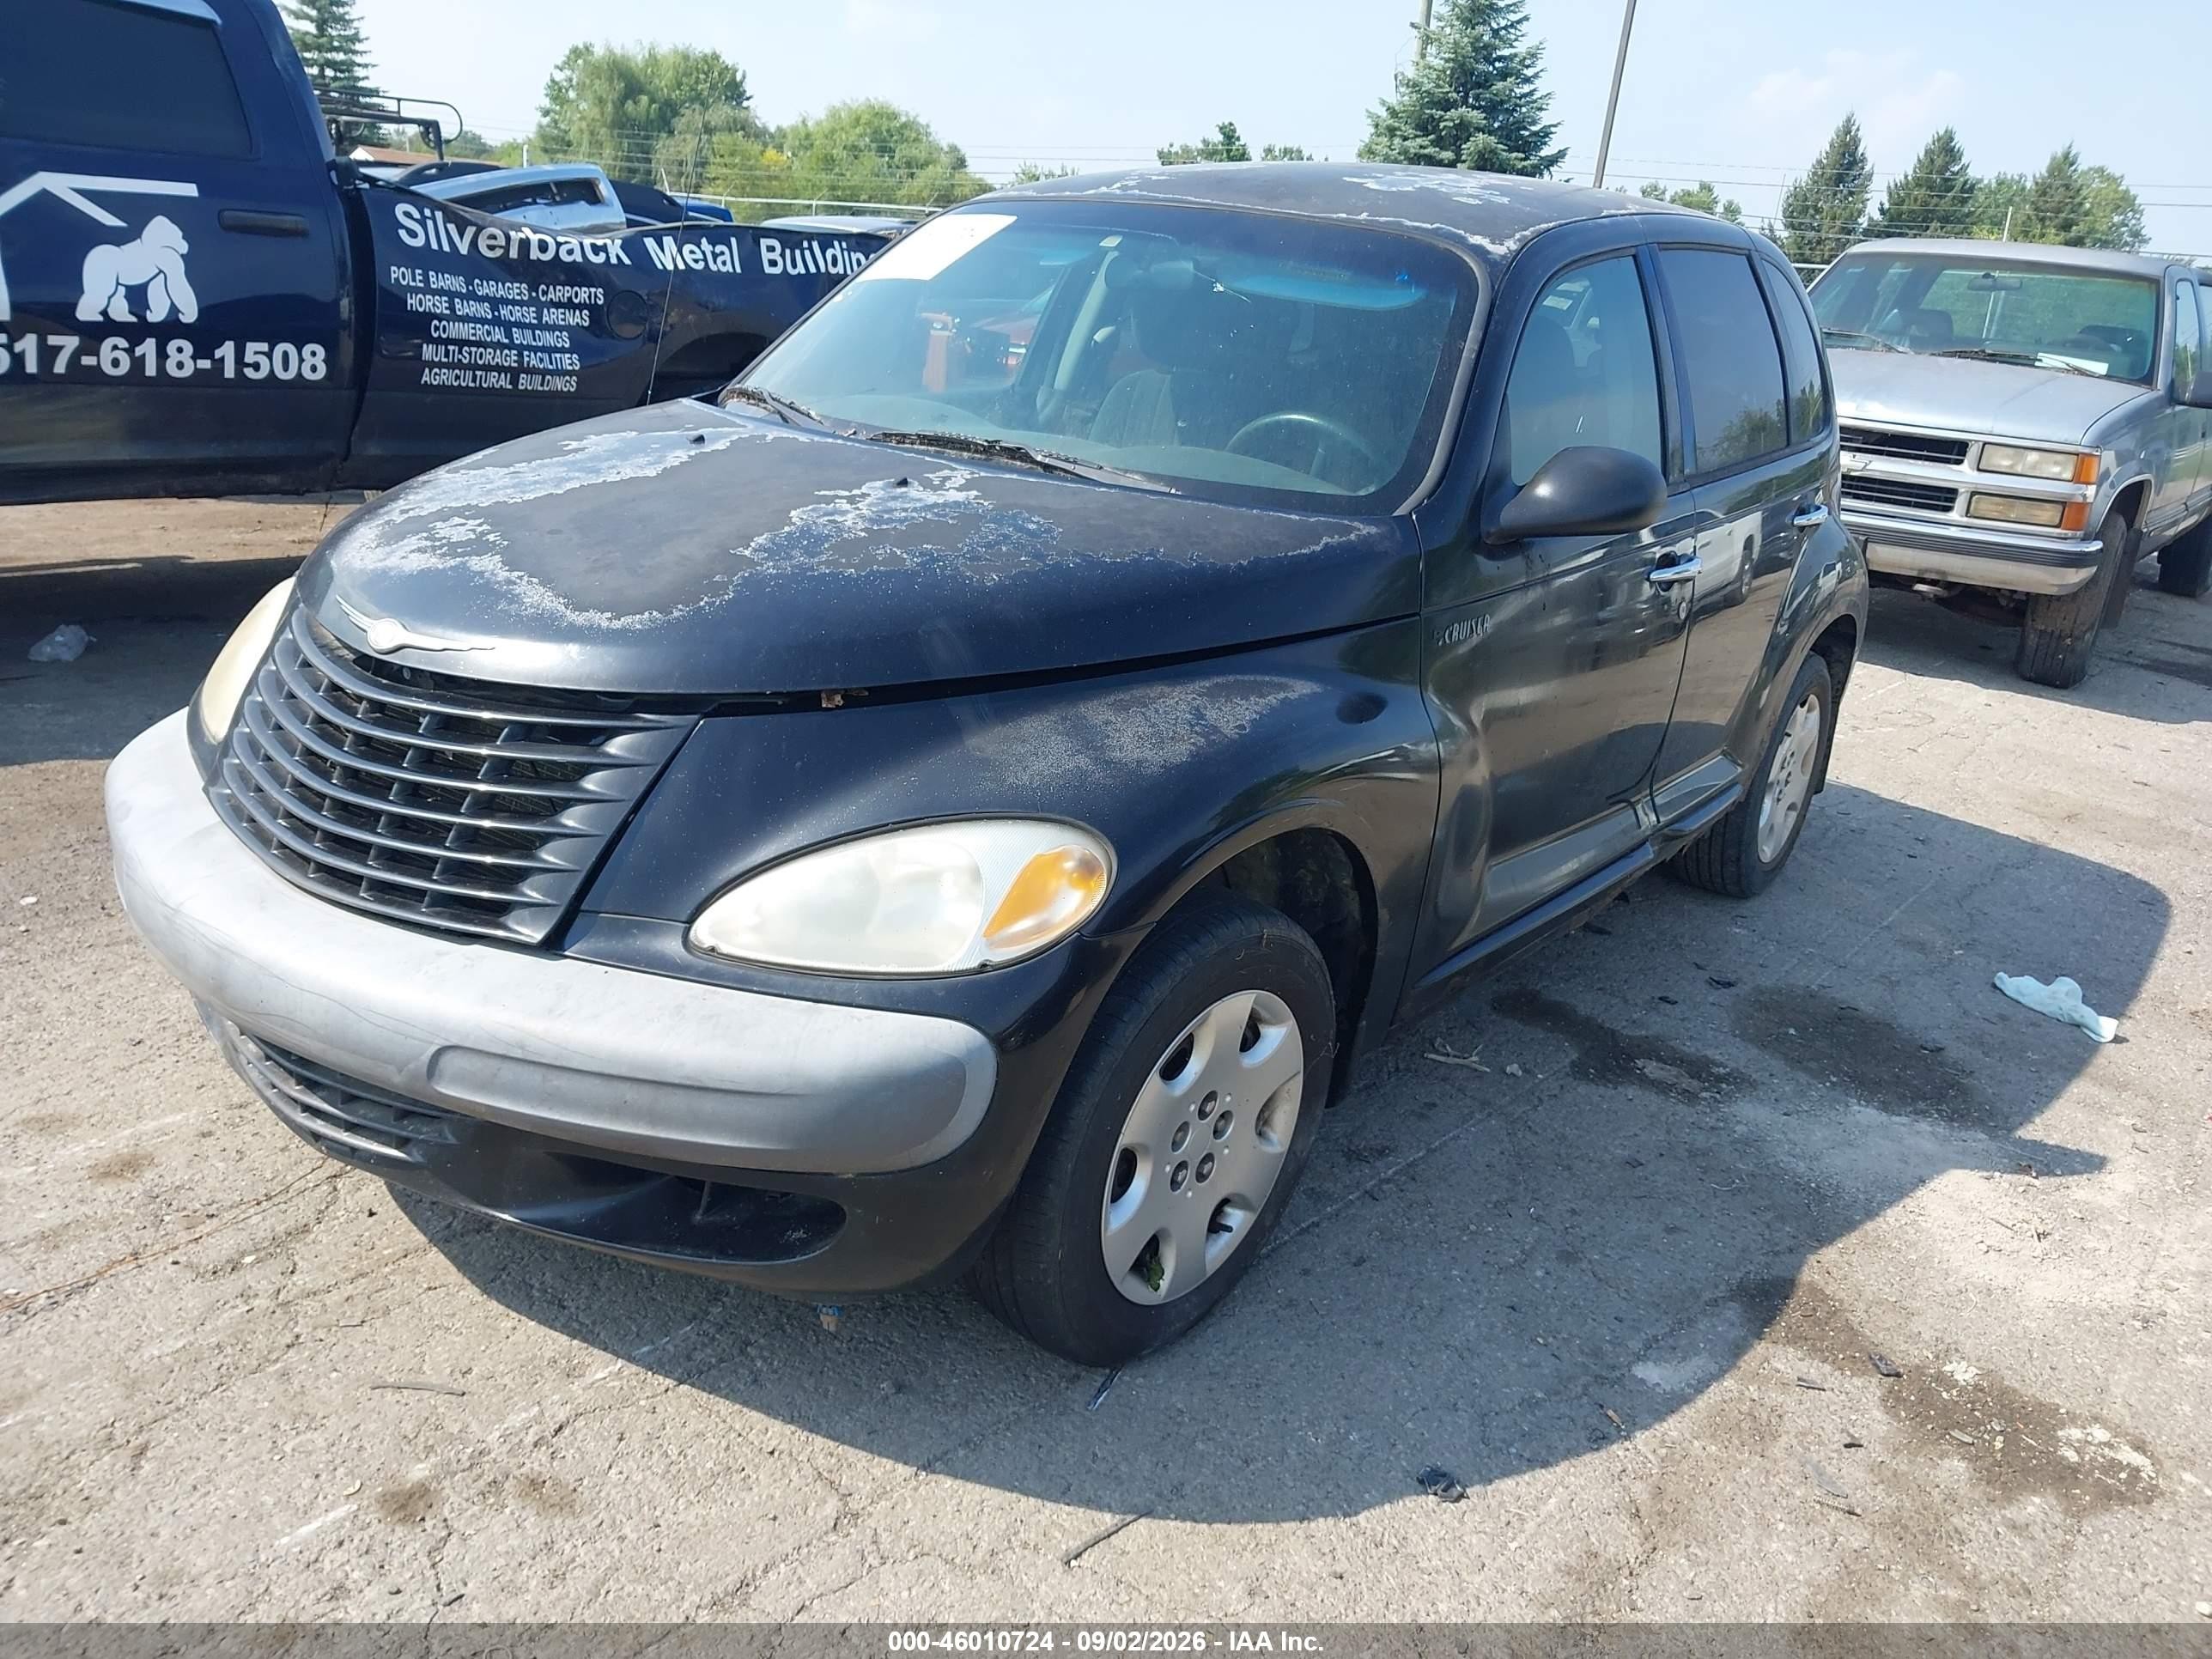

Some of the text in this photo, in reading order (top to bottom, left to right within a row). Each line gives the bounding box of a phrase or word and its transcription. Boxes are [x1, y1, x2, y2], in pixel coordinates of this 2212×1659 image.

[394, 202, 874, 276] Silverback Metal Buildin
[390, 265, 425, 288] POLE
[429, 270, 467, 294] BARNS
[474, 278, 529, 301] GARAGES
[538, 284, 605, 305] CARPORTS
[407, 293, 451, 315] HORSE
[455, 298, 493, 319] BARNS
[499, 303, 538, 325] HORSE
[542, 307, 591, 327] ARENAS
[431, 319, 570, 348] COMMERCIAL BUILDINGS
[422, 343, 580, 370] MULTI-STORAGE FACILITIES
[421, 368, 578, 392] AGRICULTURAL BUILDINGS
